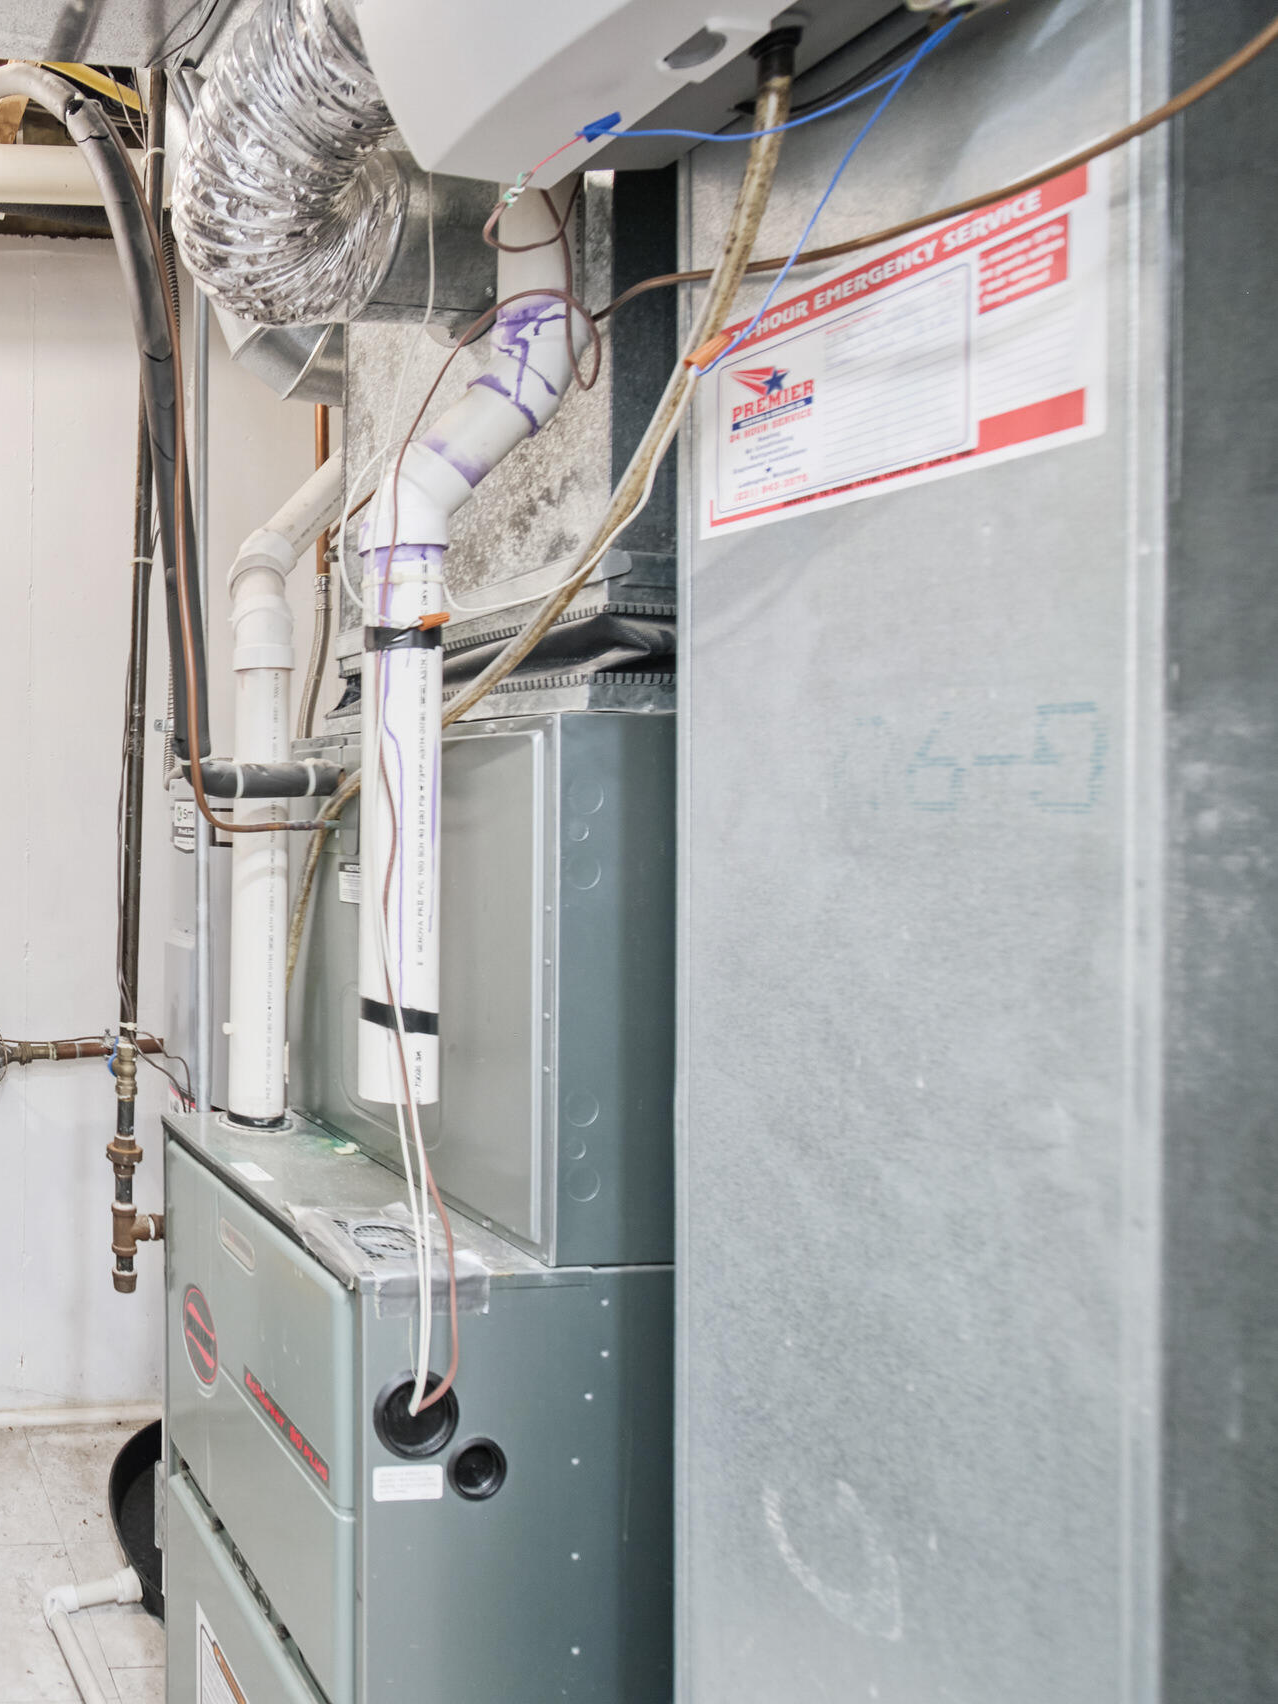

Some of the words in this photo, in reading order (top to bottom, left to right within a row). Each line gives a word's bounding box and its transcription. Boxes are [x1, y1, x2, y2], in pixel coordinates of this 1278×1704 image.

[813, 240, 938, 311] EMERGENCY
[942, 189, 1042, 252] SERVICE
[732, 379, 815, 423] PREMIER
[772, 408, 813, 430] SERVICE
